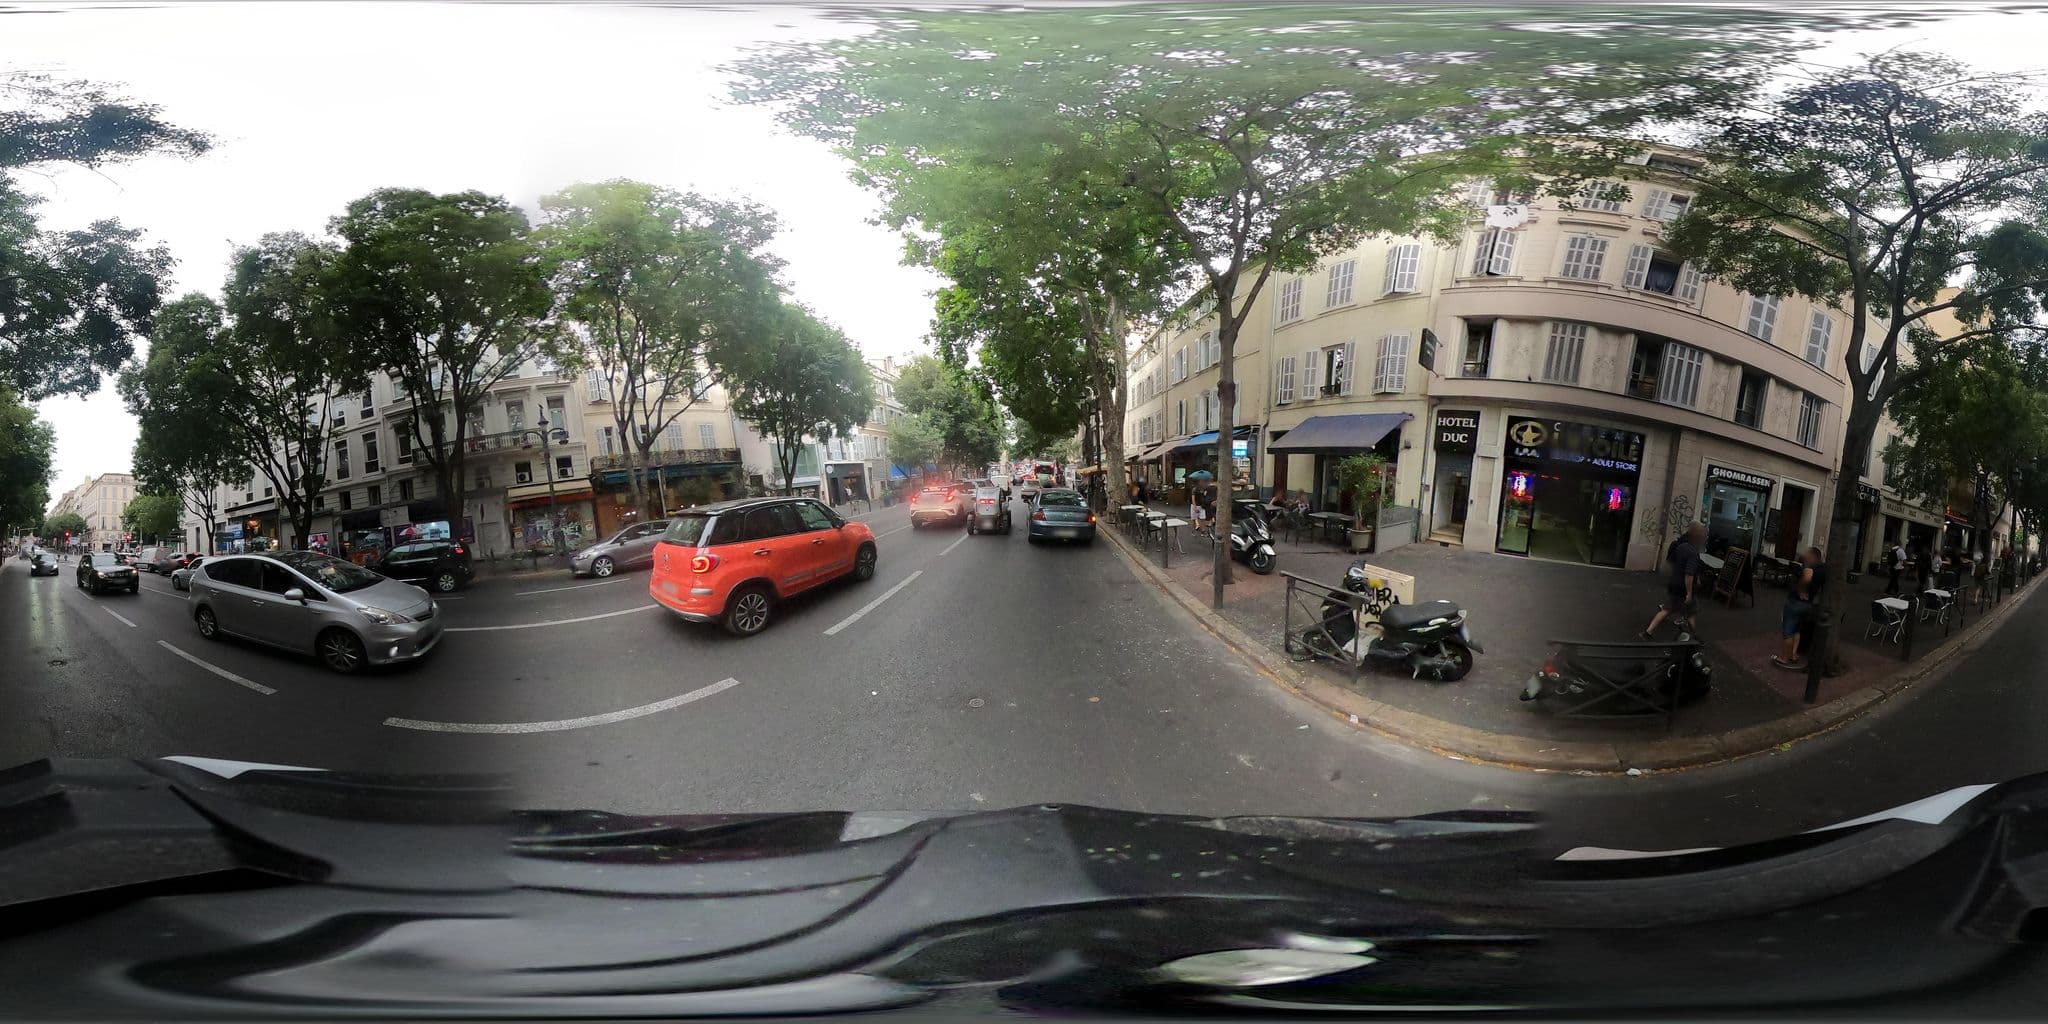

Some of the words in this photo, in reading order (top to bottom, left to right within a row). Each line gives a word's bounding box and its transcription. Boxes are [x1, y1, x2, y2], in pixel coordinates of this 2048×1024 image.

[1437, 417, 1476, 428] HOTEL
[1442, 432, 1468, 443] DUC
[1592, 457, 1614, 468] ADULT
[1615, 460, 1638, 472] STORE
